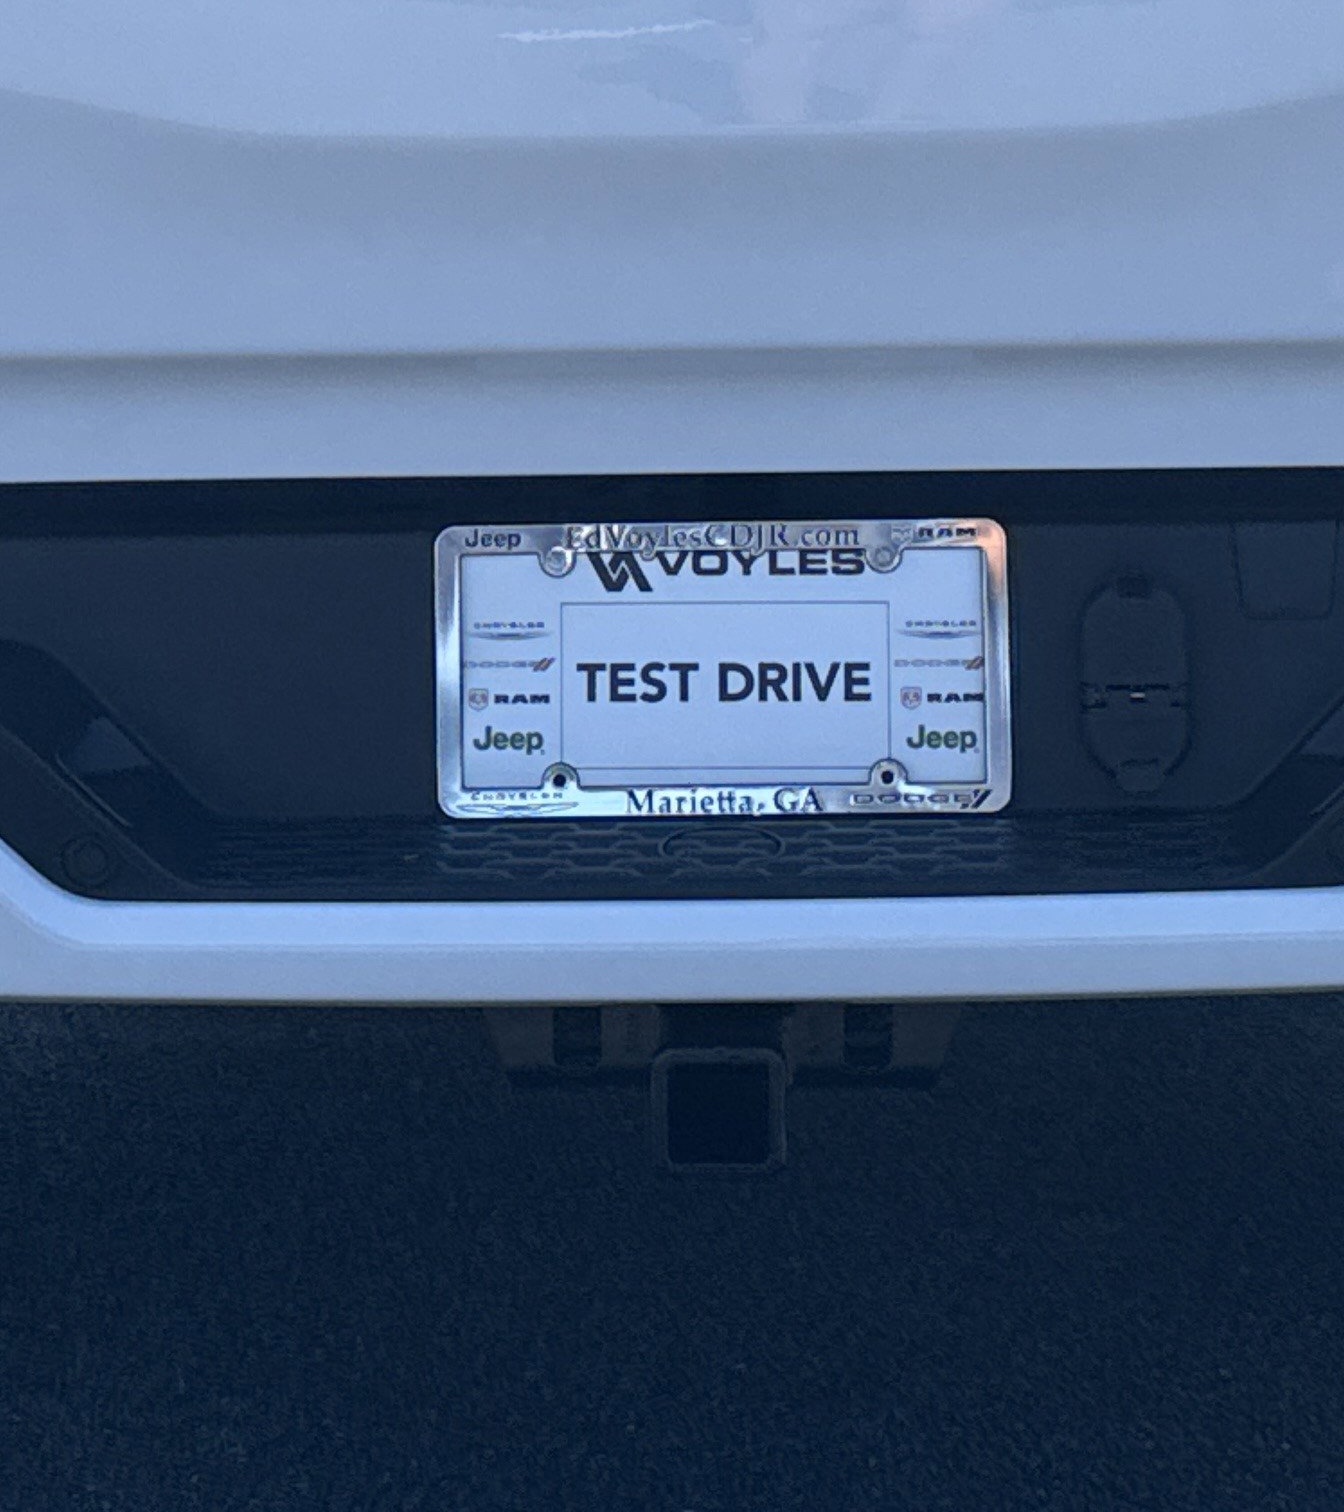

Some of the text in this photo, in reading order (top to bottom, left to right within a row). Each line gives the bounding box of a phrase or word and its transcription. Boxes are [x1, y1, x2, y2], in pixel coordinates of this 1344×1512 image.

[465, 529, 522, 550] Jeep
[656, 549, 867, 576] VOYLES
[576, 661, 872, 702] TEST DRIVE
[493, 693, 551, 705] RAM
[926, 692, 984, 704] RAM
[472, 725, 544, 756] Jeep
[905, 724, 978, 754] Jeep
[625, 787, 824, 814] Marietta, GA
